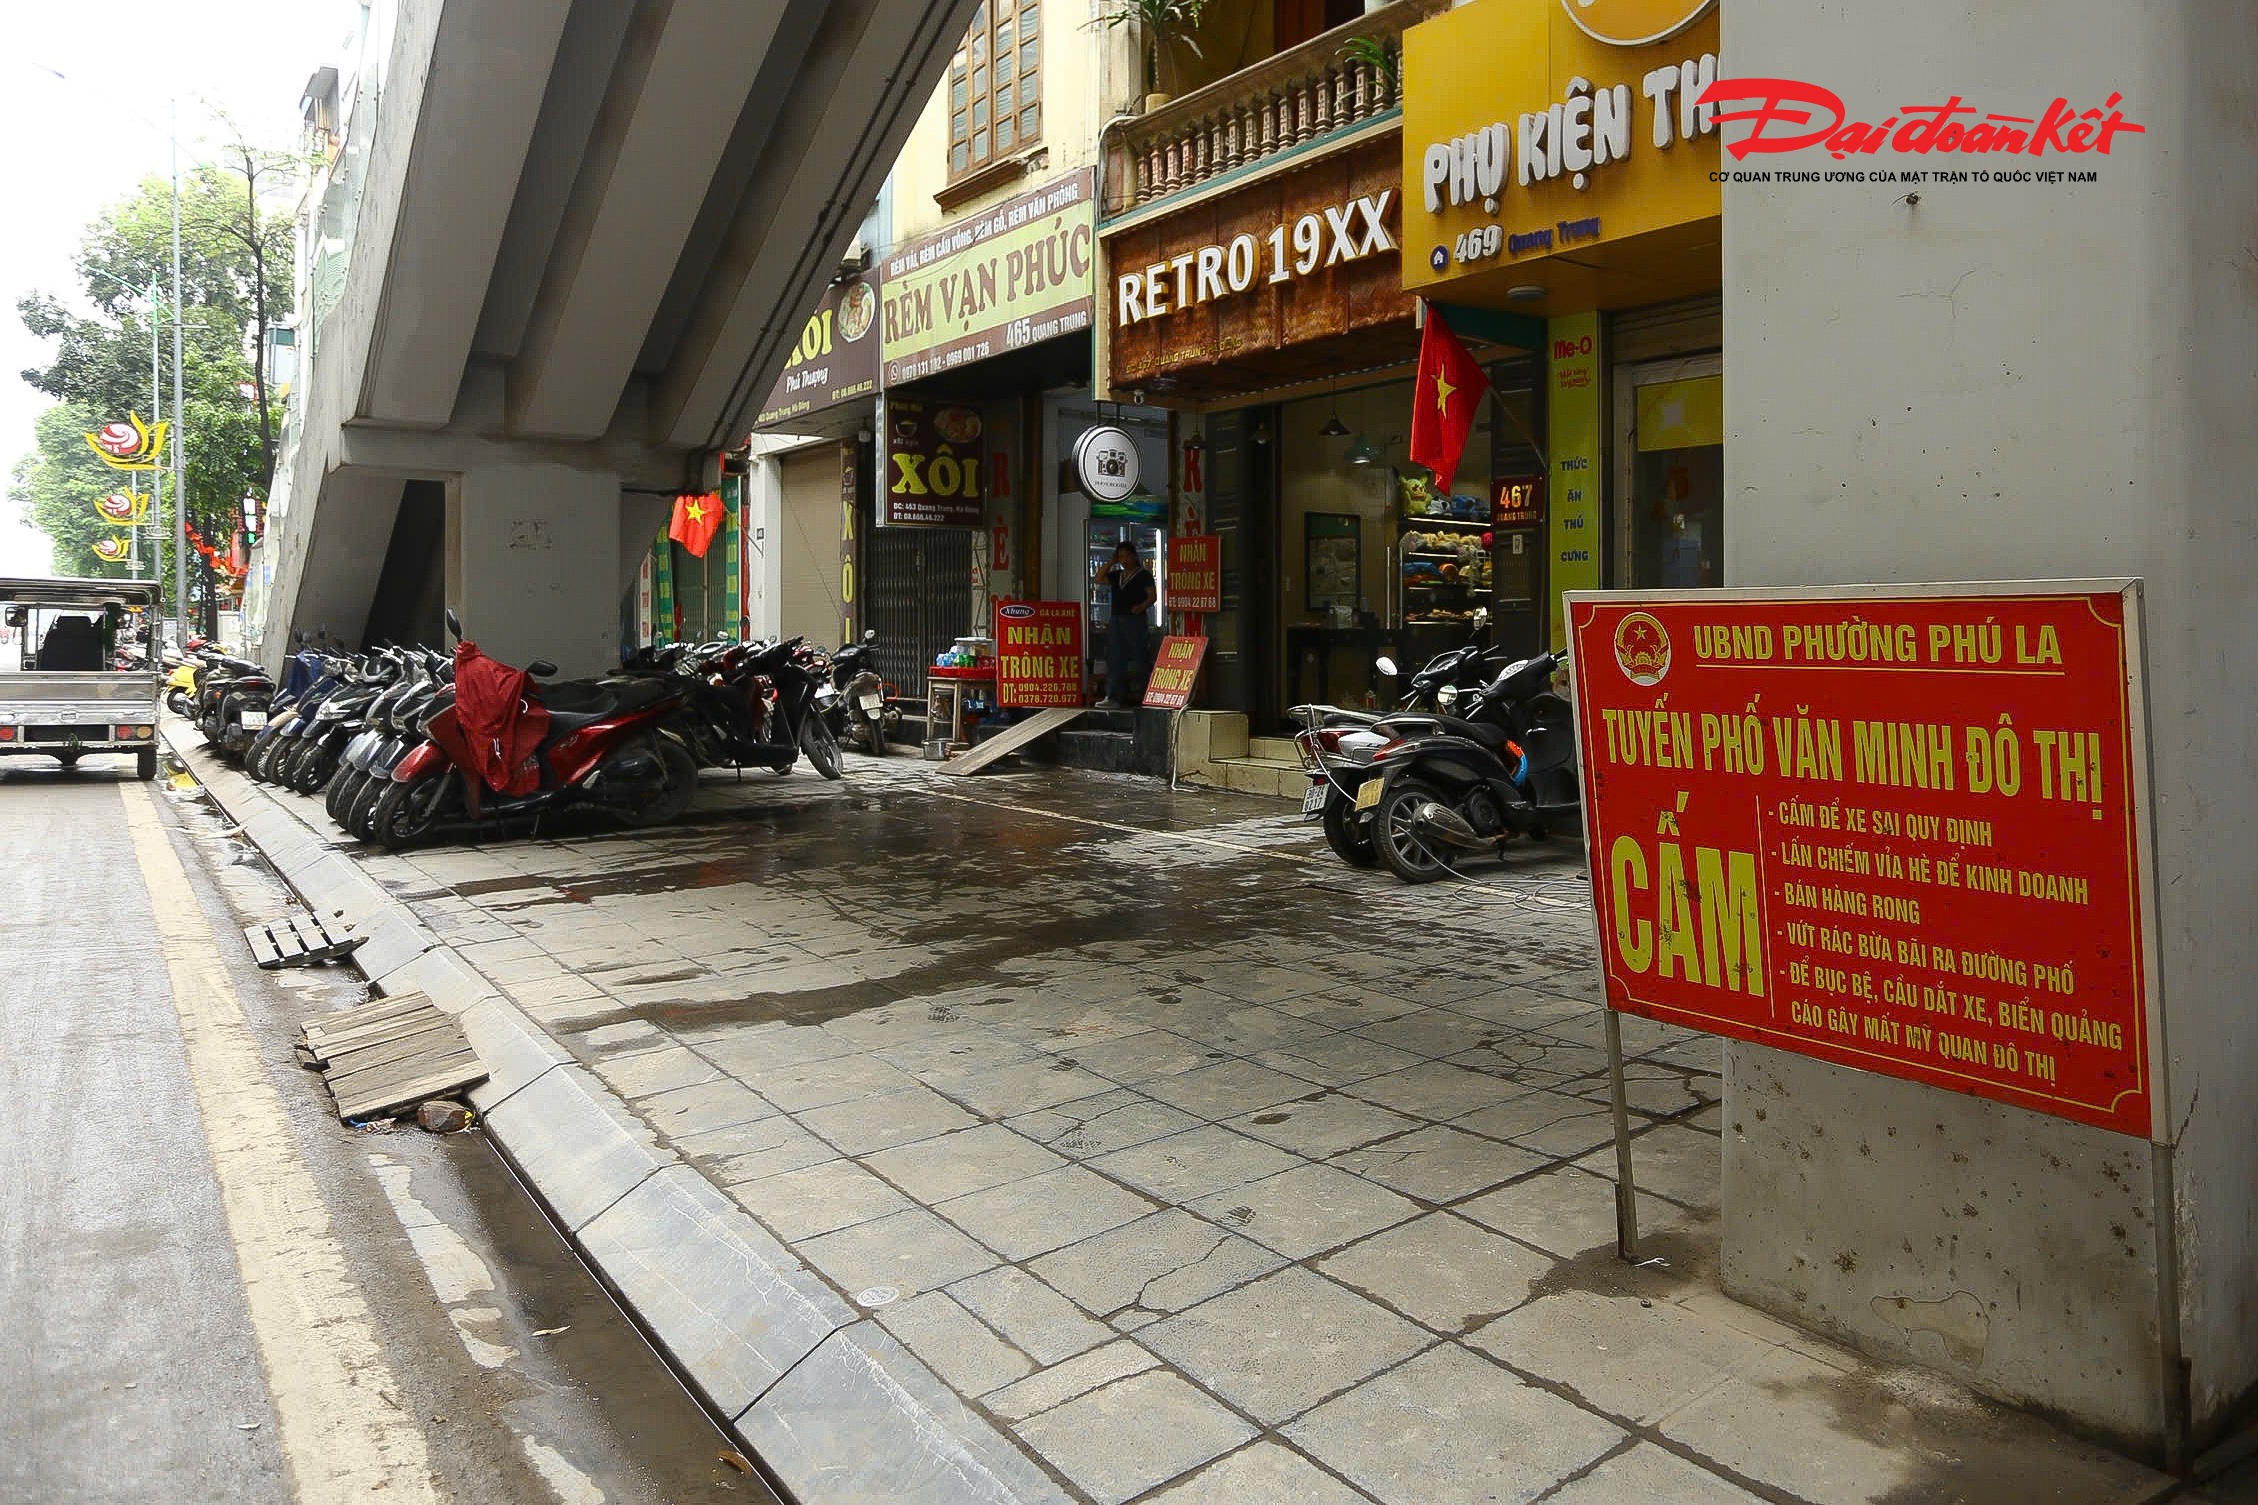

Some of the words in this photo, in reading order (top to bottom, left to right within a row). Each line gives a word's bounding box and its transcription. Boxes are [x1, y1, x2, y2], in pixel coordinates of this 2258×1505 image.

[1424, 122, 1510, 215] PHỤ
[1518, 76, 1631, 190] KIỆN
[1642, 53, 1722, 150] TH
[1008, 205, 1027, 228] RÈM
[1047, 182, 1078, 211] PHÒNG
[1118, 232, 1257, 328] RETRO
[1268, 188, 1398, 285] 19XX
[1453, 225, 1502, 263] 469
[883, 275, 933, 344] RÈM
[940, 258, 999, 332] VẠN
[1007, 216, 1090, 303] PHÚC
[1005, 318, 1031, 348] 465
[1032, 321, 1059, 342] QUANG
[1060, 310, 1087, 332] TRUNG
[891, 443, 979, 498] XÔI
[1561, 456, 1588, 471] THỨC
[1500, 484, 1533, 509] 467
[1564, 515, 1584, 530] THÚ
[842, 500, 854, 644] XÔI
[1179, 540, 1207, 566] NHẬN
[1170, 569, 1200, 591] TRÔNG
[1203, 571, 1216, 590] XE
[1007, 623, 1071, 649] NHẬN
[1168, 640, 1195, 663] NHẬN
[1693, 625, 1772, 660] UBND
[1784, 614, 1916, 664] PHƯỜNG
[1929, 615, 2002, 664] PHÚ
[2016, 625, 2063, 665] LA
[1000, 651, 1055, 679] TRÔNG
[1060, 655, 1079, 679] XE
[1152, 664, 1181, 690] TRÔNG
[1178, 668, 1194, 691] XE
[1602, 692, 1693, 768] TUYẾN
[1701, 693, 1765, 776] PHỐ
[1773, 705, 1843, 782] VĂN
[1853, 720, 1954, 791] MINH
[1966, 714, 2022, 797] ĐÔ
[2033, 729, 2103, 820] THỊ
[1778, 795, 1815, 827] CẤM
[1819, 797, 1841, 830] ĐỂ
[1845, 807, 1867, 833] XE
[1872, 810, 1901, 837] SAI
[1905, 814, 1940, 841] QUY
[1946, 817, 1992, 850] ĐỊNH
[1610, 790, 1765, 998] CẤM
[1781, 835, 1812, 868] LẤN
[1817, 842, 1870, 875] CHIẾM
[1875, 846, 1904, 879] VỈA
[1908, 853, 1931, 883] HÈ
[1936, 852, 1960, 888] ĐỂ
[1966, 864, 2013, 895] KINH
[2018, 870, 2088, 905] DOANH
[1784, 879, 1817, 909] BÁN
[1821, 884, 1867, 917] HÀNG
[1872, 894, 1920, 925] RONG
[1787, 919, 1815, 948] VỨT
[1820, 924, 1853, 955] RÁC
[1858, 930, 1893, 962] BỪA
[1897, 937, 1927, 968] BÃI
[1932, 946, 1957, 973] RA
[1961, 949, 2027, 987] ĐƯỜNG
[2034, 960, 2074, 995] PHỐ
[1790, 955, 1810, 987] ĐỂ
[1814, 966, 1847, 996] BỤC
[1851, 971, 1878, 1004] BỆ,
[1883, 974, 1918, 1008] CẦU
[1923, 980, 1957, 1016] DẮT
[1963, 994, 1993, 1027] XE,
[1998, 996, 2045, 1034] BIỂN
[2051, 1008, 2122, 1051] QUẢNG
[1791, 999, 1823, 1028] CÁO
[1827, 1006, 1858, 1036] GÂY
[1864, 1012, 1900, 1045] MẤT
[1905, 1023, 1932, 1052] MỸ
[1938, 1031, 1988, 1065] QUAN
[1993, 1042, 2018, 1072] ĐÔ
[2024, 1050, 2056, 1087] THỊ
